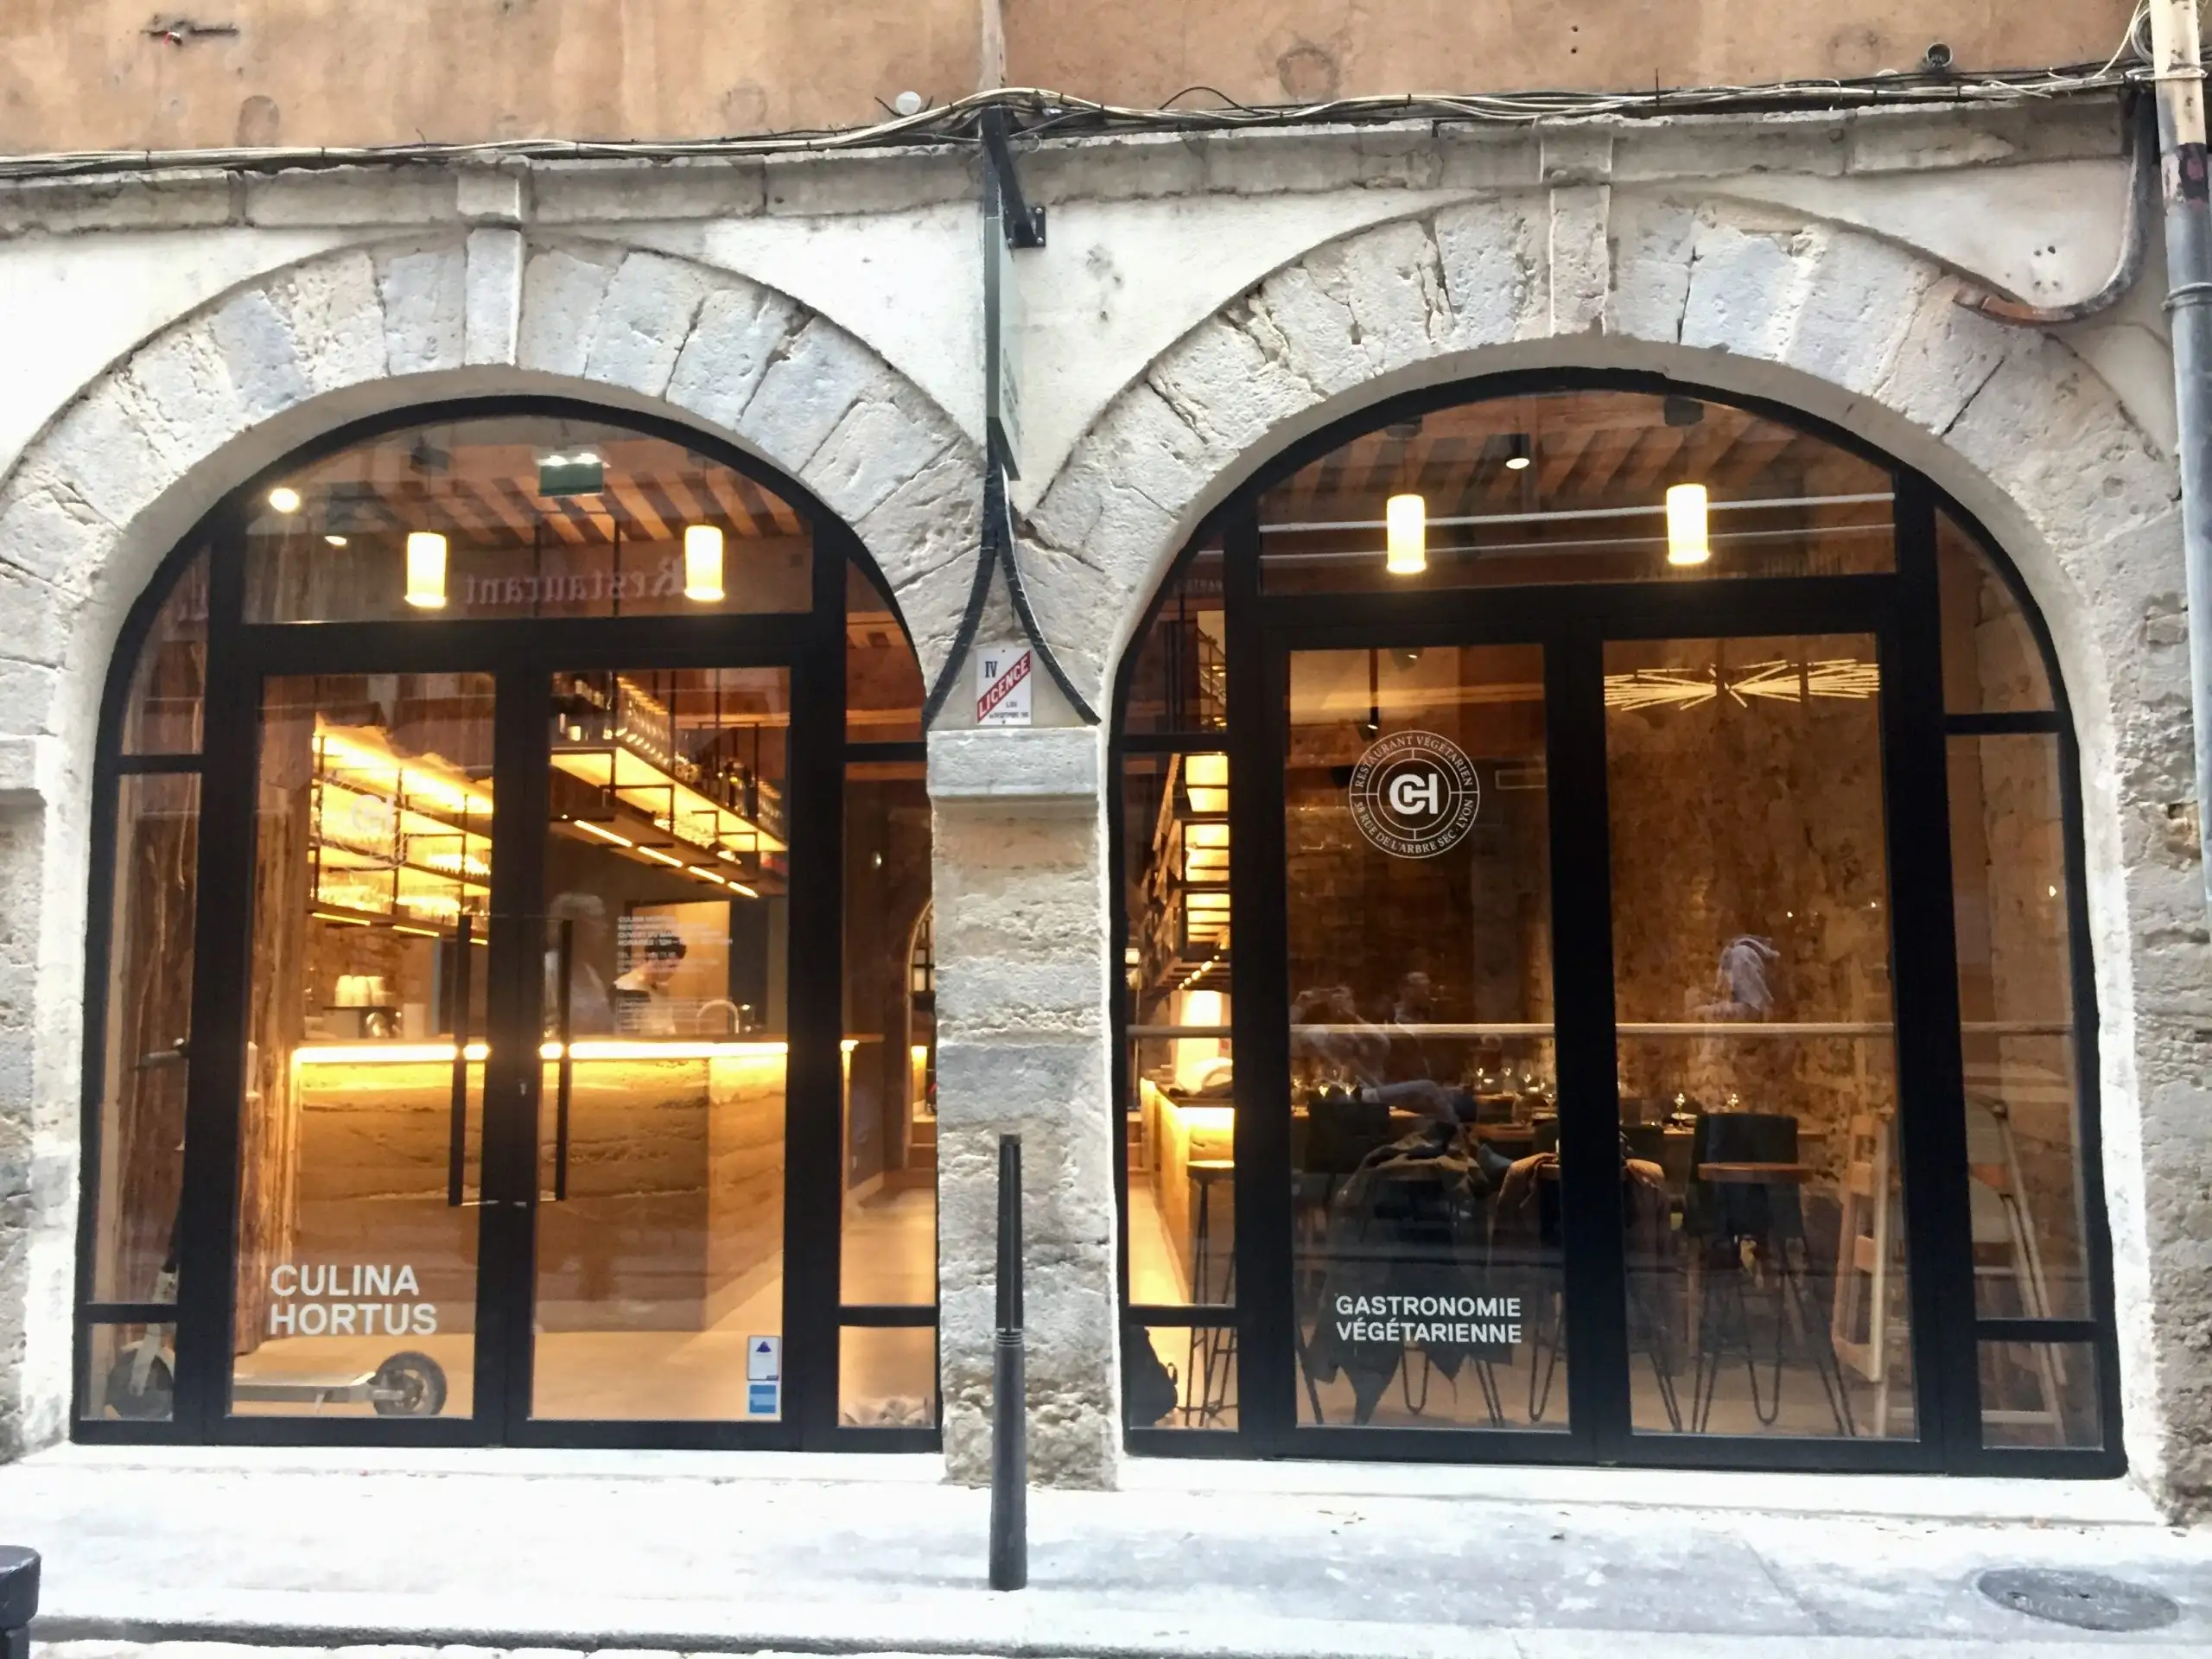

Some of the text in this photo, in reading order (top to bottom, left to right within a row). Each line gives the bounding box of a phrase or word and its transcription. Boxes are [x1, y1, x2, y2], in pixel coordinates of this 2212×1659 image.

[984, 660, 998, 678] IV
[978, 656, 1028, 718] LICENCE
[1354, 735, 1413, 788] RESTAURANT
[1360, 814, 1378, 836] RUE
[1376, 832, 1390, 847] DE
[1391, 841, 1437, 854] L'ARBRE
[1438, 830, 1457, 848] SEC
[1456, 798, 1474, 830] LYON
[270, 1264, 419, 1296] CULINA
[270, 1303, 437, 1335] HORTUS
[1336, 1295, 1522, 1318] GASTRONOMIE
[1336, 1317, 1522, 1344] VÉGÉTARIENNE
